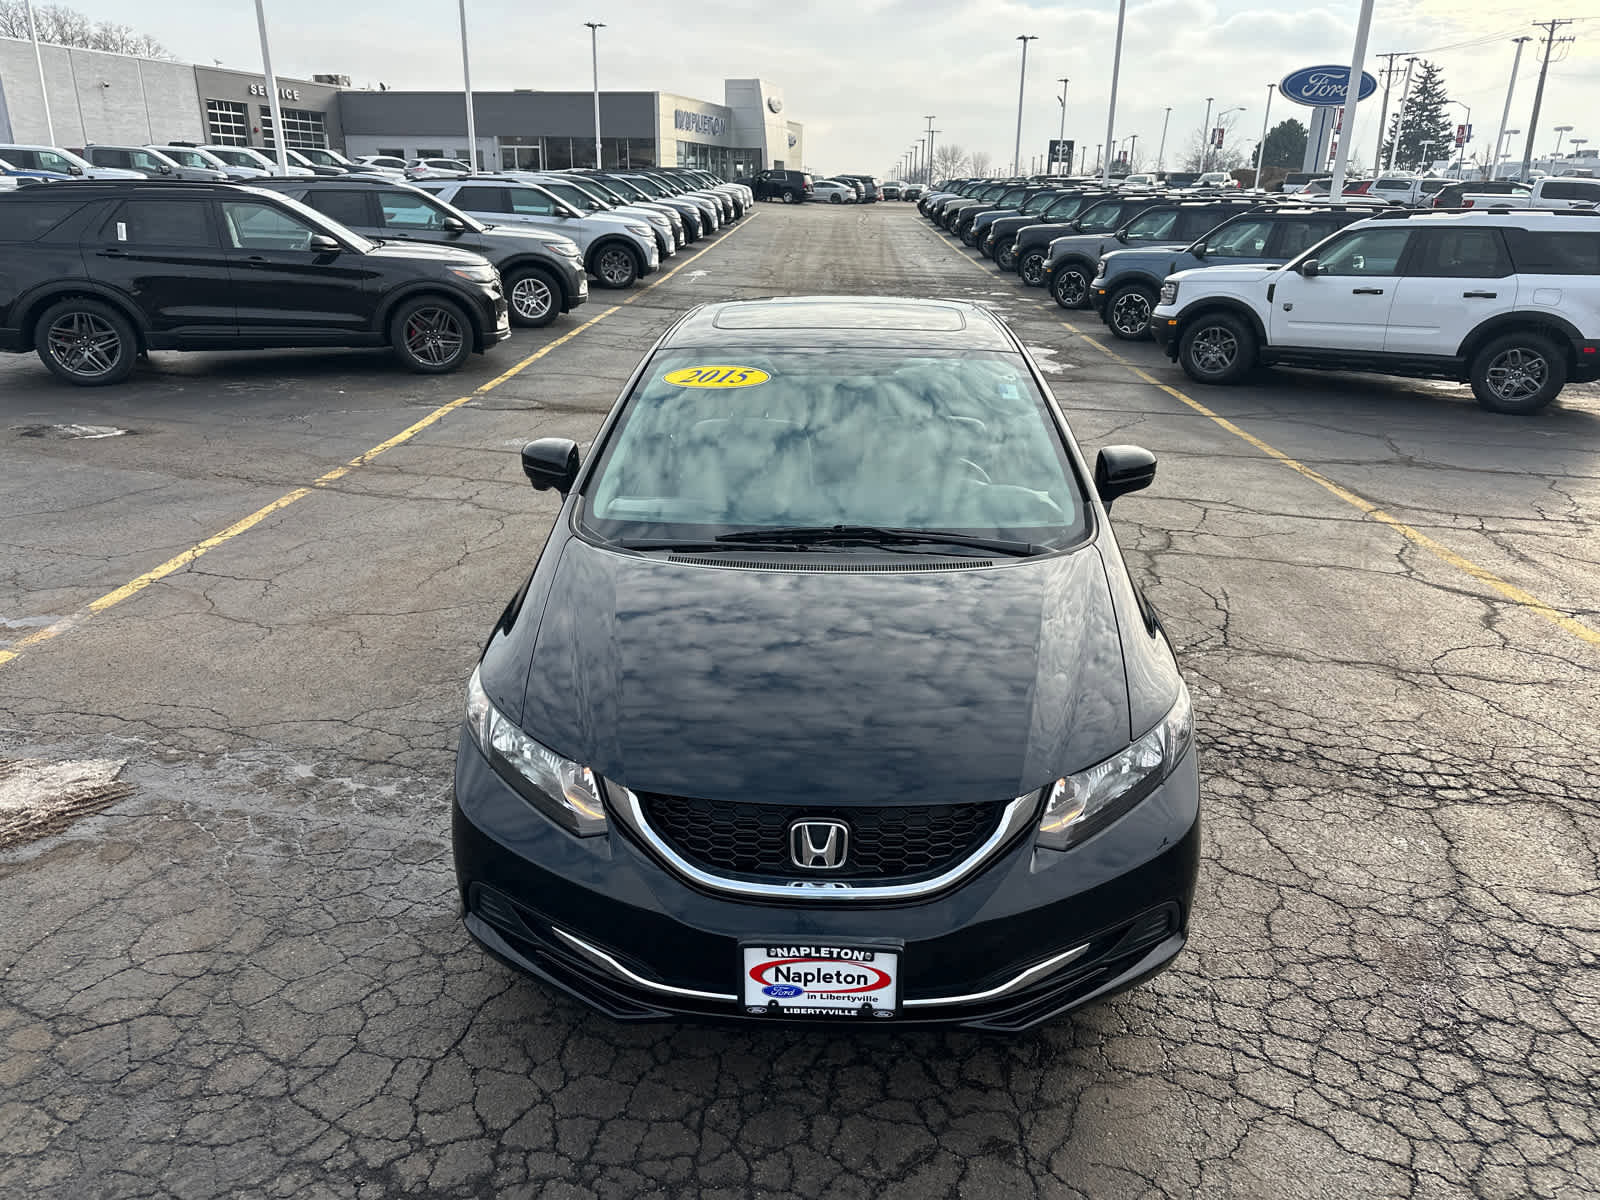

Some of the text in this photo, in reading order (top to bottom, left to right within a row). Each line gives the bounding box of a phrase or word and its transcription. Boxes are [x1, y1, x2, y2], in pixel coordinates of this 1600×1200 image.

[250, 84, 300, 101] SEICE
[680, 369, 754, 383] 2015
[776, 947, 865, 961] NAPLETON
[774, 966, 868, 986] Napleton
[770, 986, 795, 996] Ford
[820, 993, 879, 1003] Libertyville
[783, 1007, 858, 1016] LIBERTYVILLE
